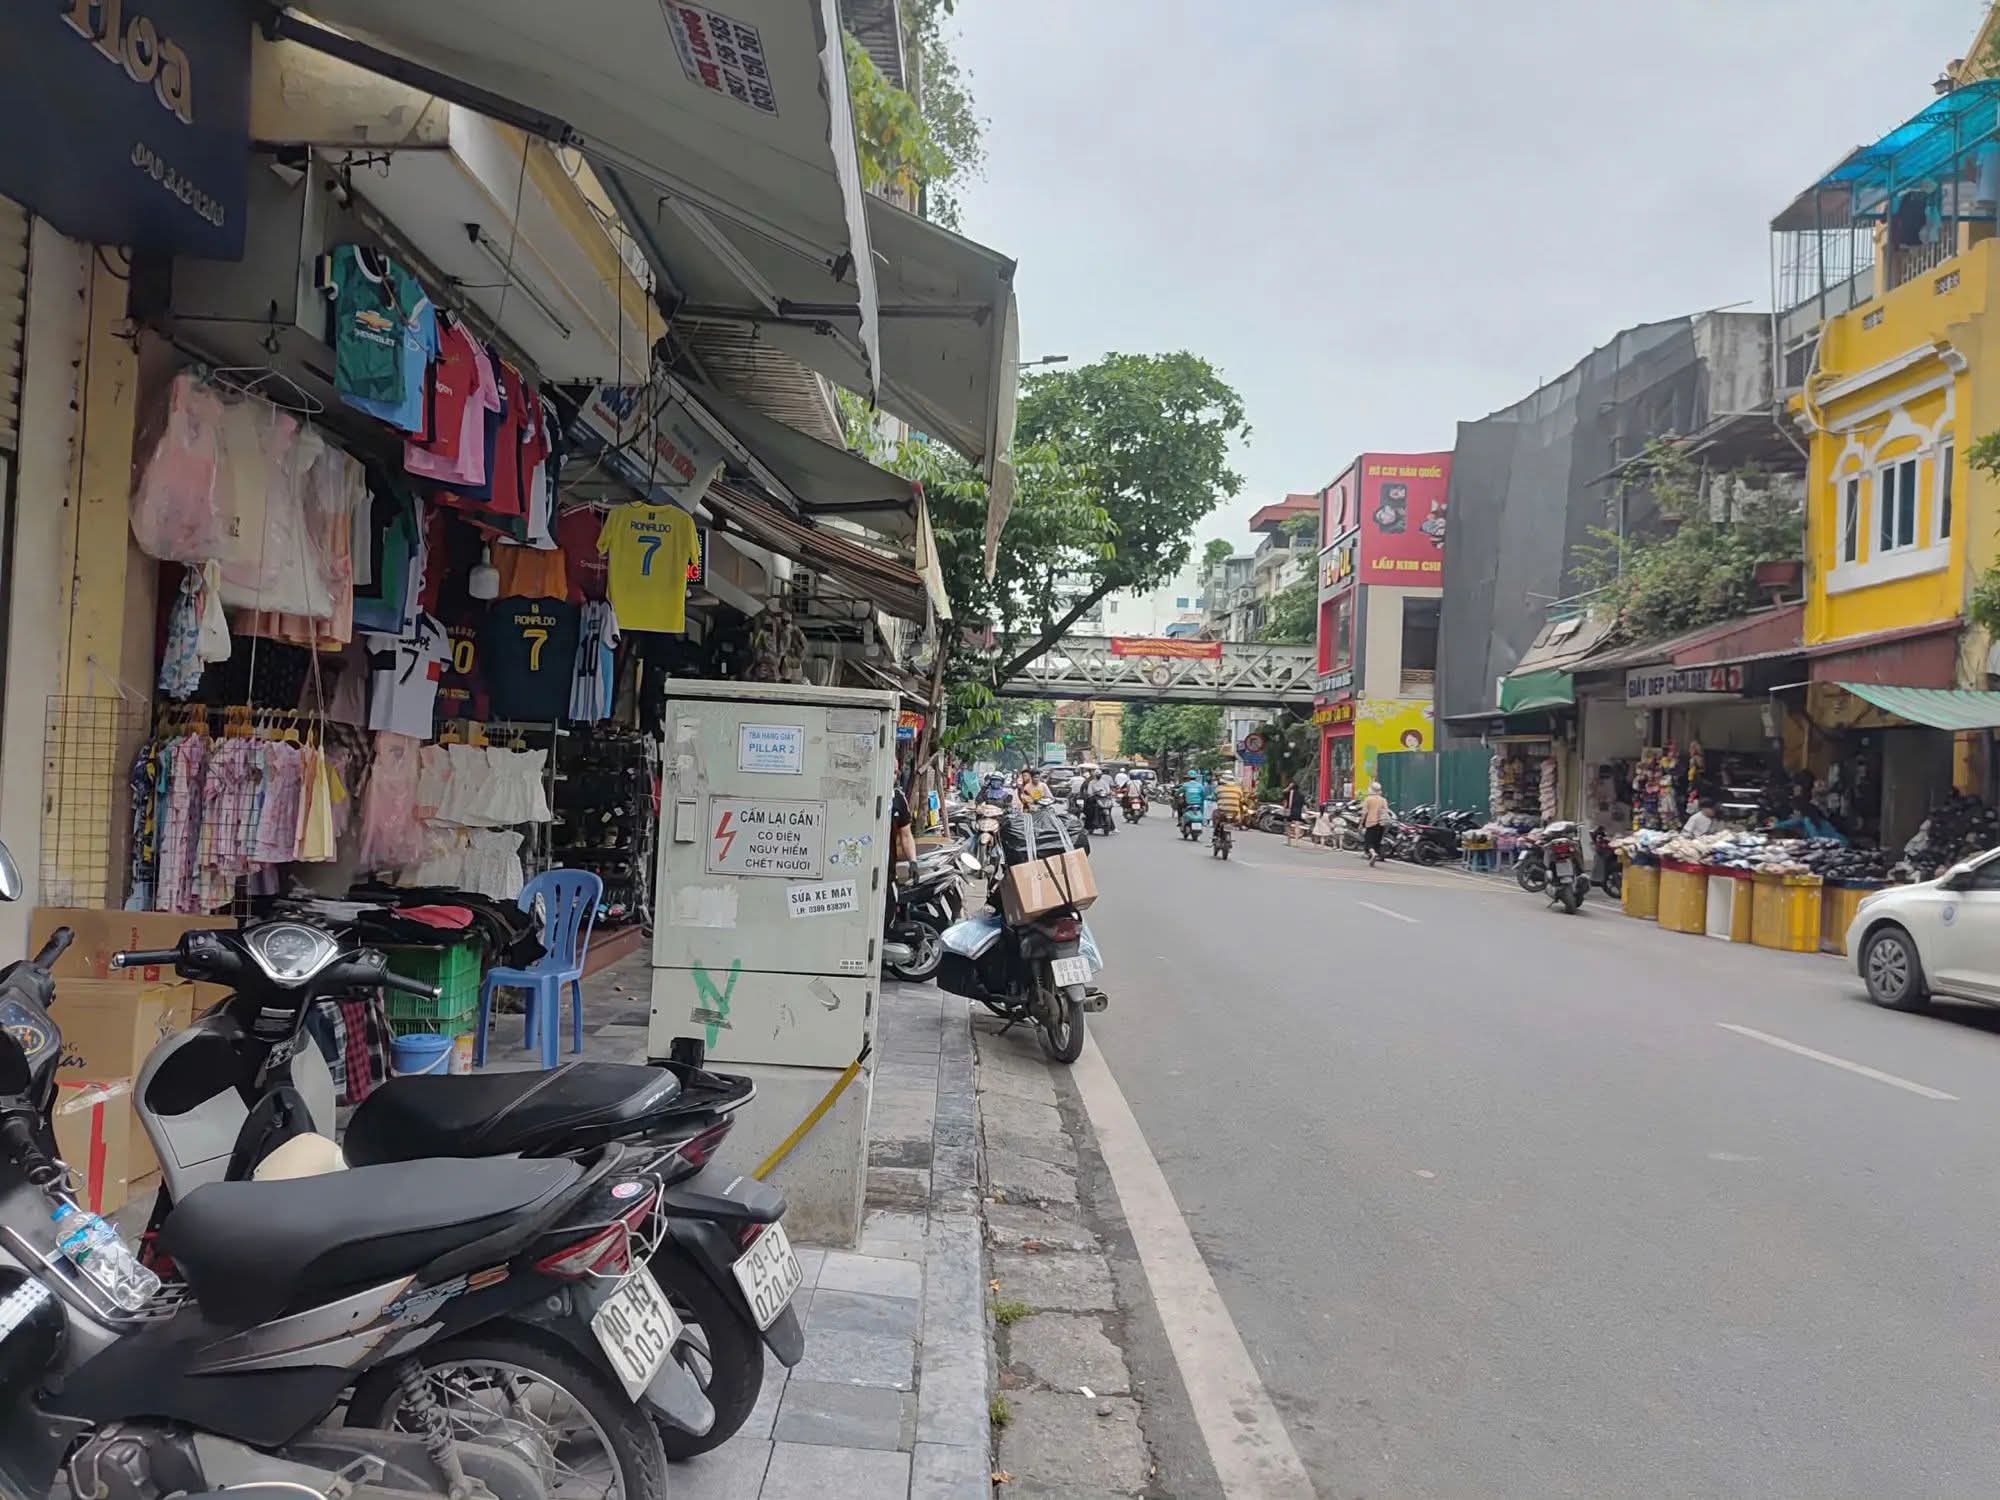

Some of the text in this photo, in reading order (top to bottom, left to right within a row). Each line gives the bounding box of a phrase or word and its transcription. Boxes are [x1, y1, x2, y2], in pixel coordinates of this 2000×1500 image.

[630, 521, 672, 533] RONALDO
[637, 535, 661, 576] 7
[514, 615, 557, 626] RONALDO
[523, 628, 548, 672] 7
[399, 647, 420, 686] 7
[749, 743, 795, 754] PILLAR 2
[769, 812, 786, 828] LẠI
[749, 845, 779, 854] NGUY
[815, 890, 827, 900] XE
[747, 1230, 786, 1289] 29-C2
[754, 1255, 800, 1323] 020.40
